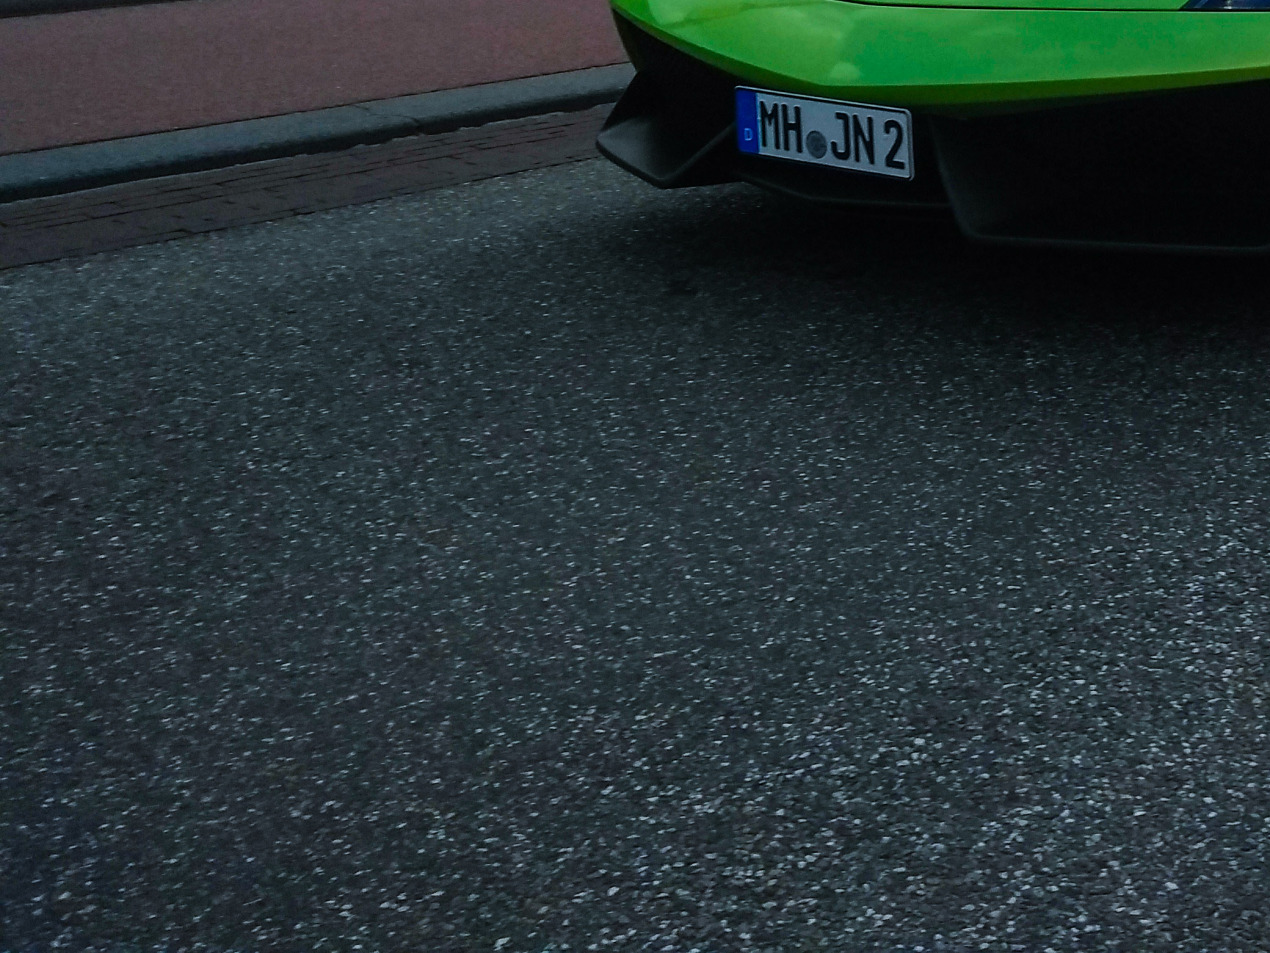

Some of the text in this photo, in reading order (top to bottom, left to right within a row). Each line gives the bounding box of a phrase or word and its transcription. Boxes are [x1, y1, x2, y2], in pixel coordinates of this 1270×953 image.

[744, 100, 905, 169] D MH JN 2
